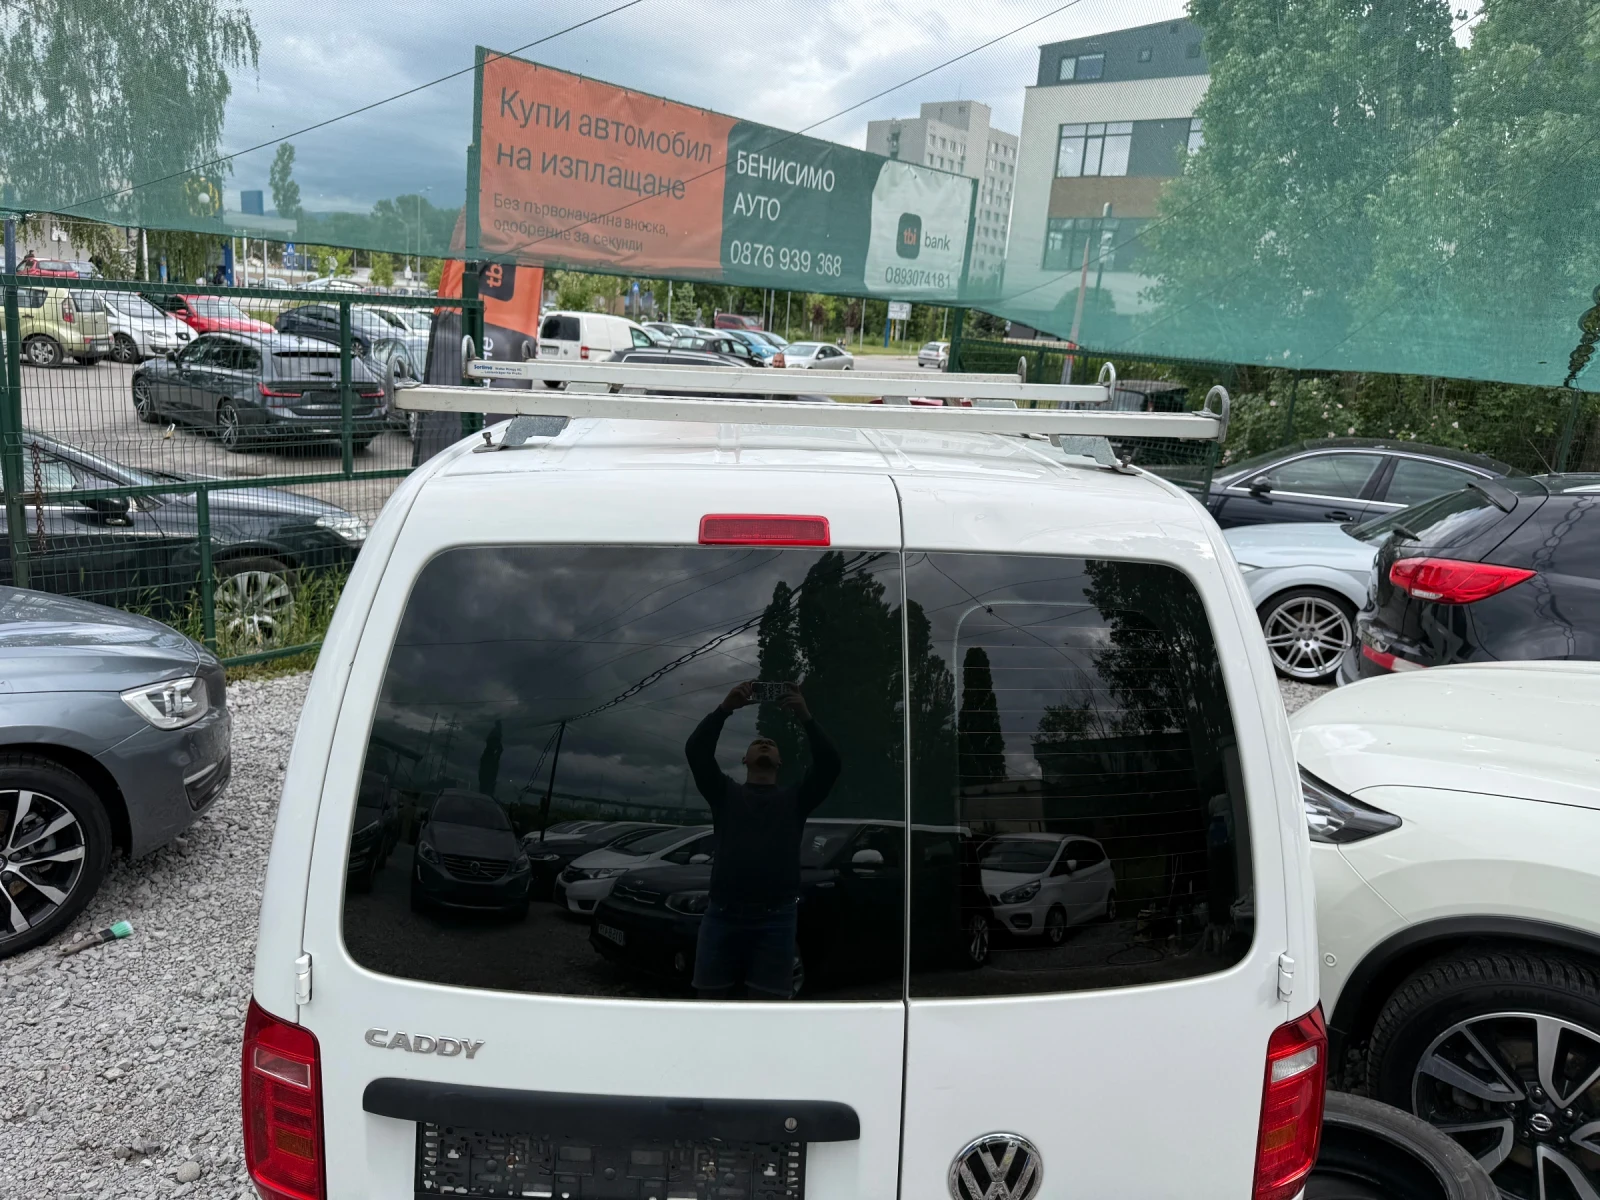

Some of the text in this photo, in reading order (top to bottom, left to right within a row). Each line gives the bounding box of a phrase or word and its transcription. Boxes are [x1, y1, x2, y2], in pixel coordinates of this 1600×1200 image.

[500, 86, 712, 164] Купи автомобил
[497, 142, 686, 200] на изплащане
[736, 150, 836, 193] БЕНИСИМО
[493, 192, 668, 237] Без първоначална вноска,
[733, 192, 781, 222] АУТО
[493, 218, 643, 252] одобрение за секунди
[903, 227, 951, 251] tbi bank
[485, 263, 504, 288] tb
[730, 239, 842, 278] 0876 939 368
[885, 266, 950, 289] 0893074181
[364, 1027, 486, 1060] CADDY
